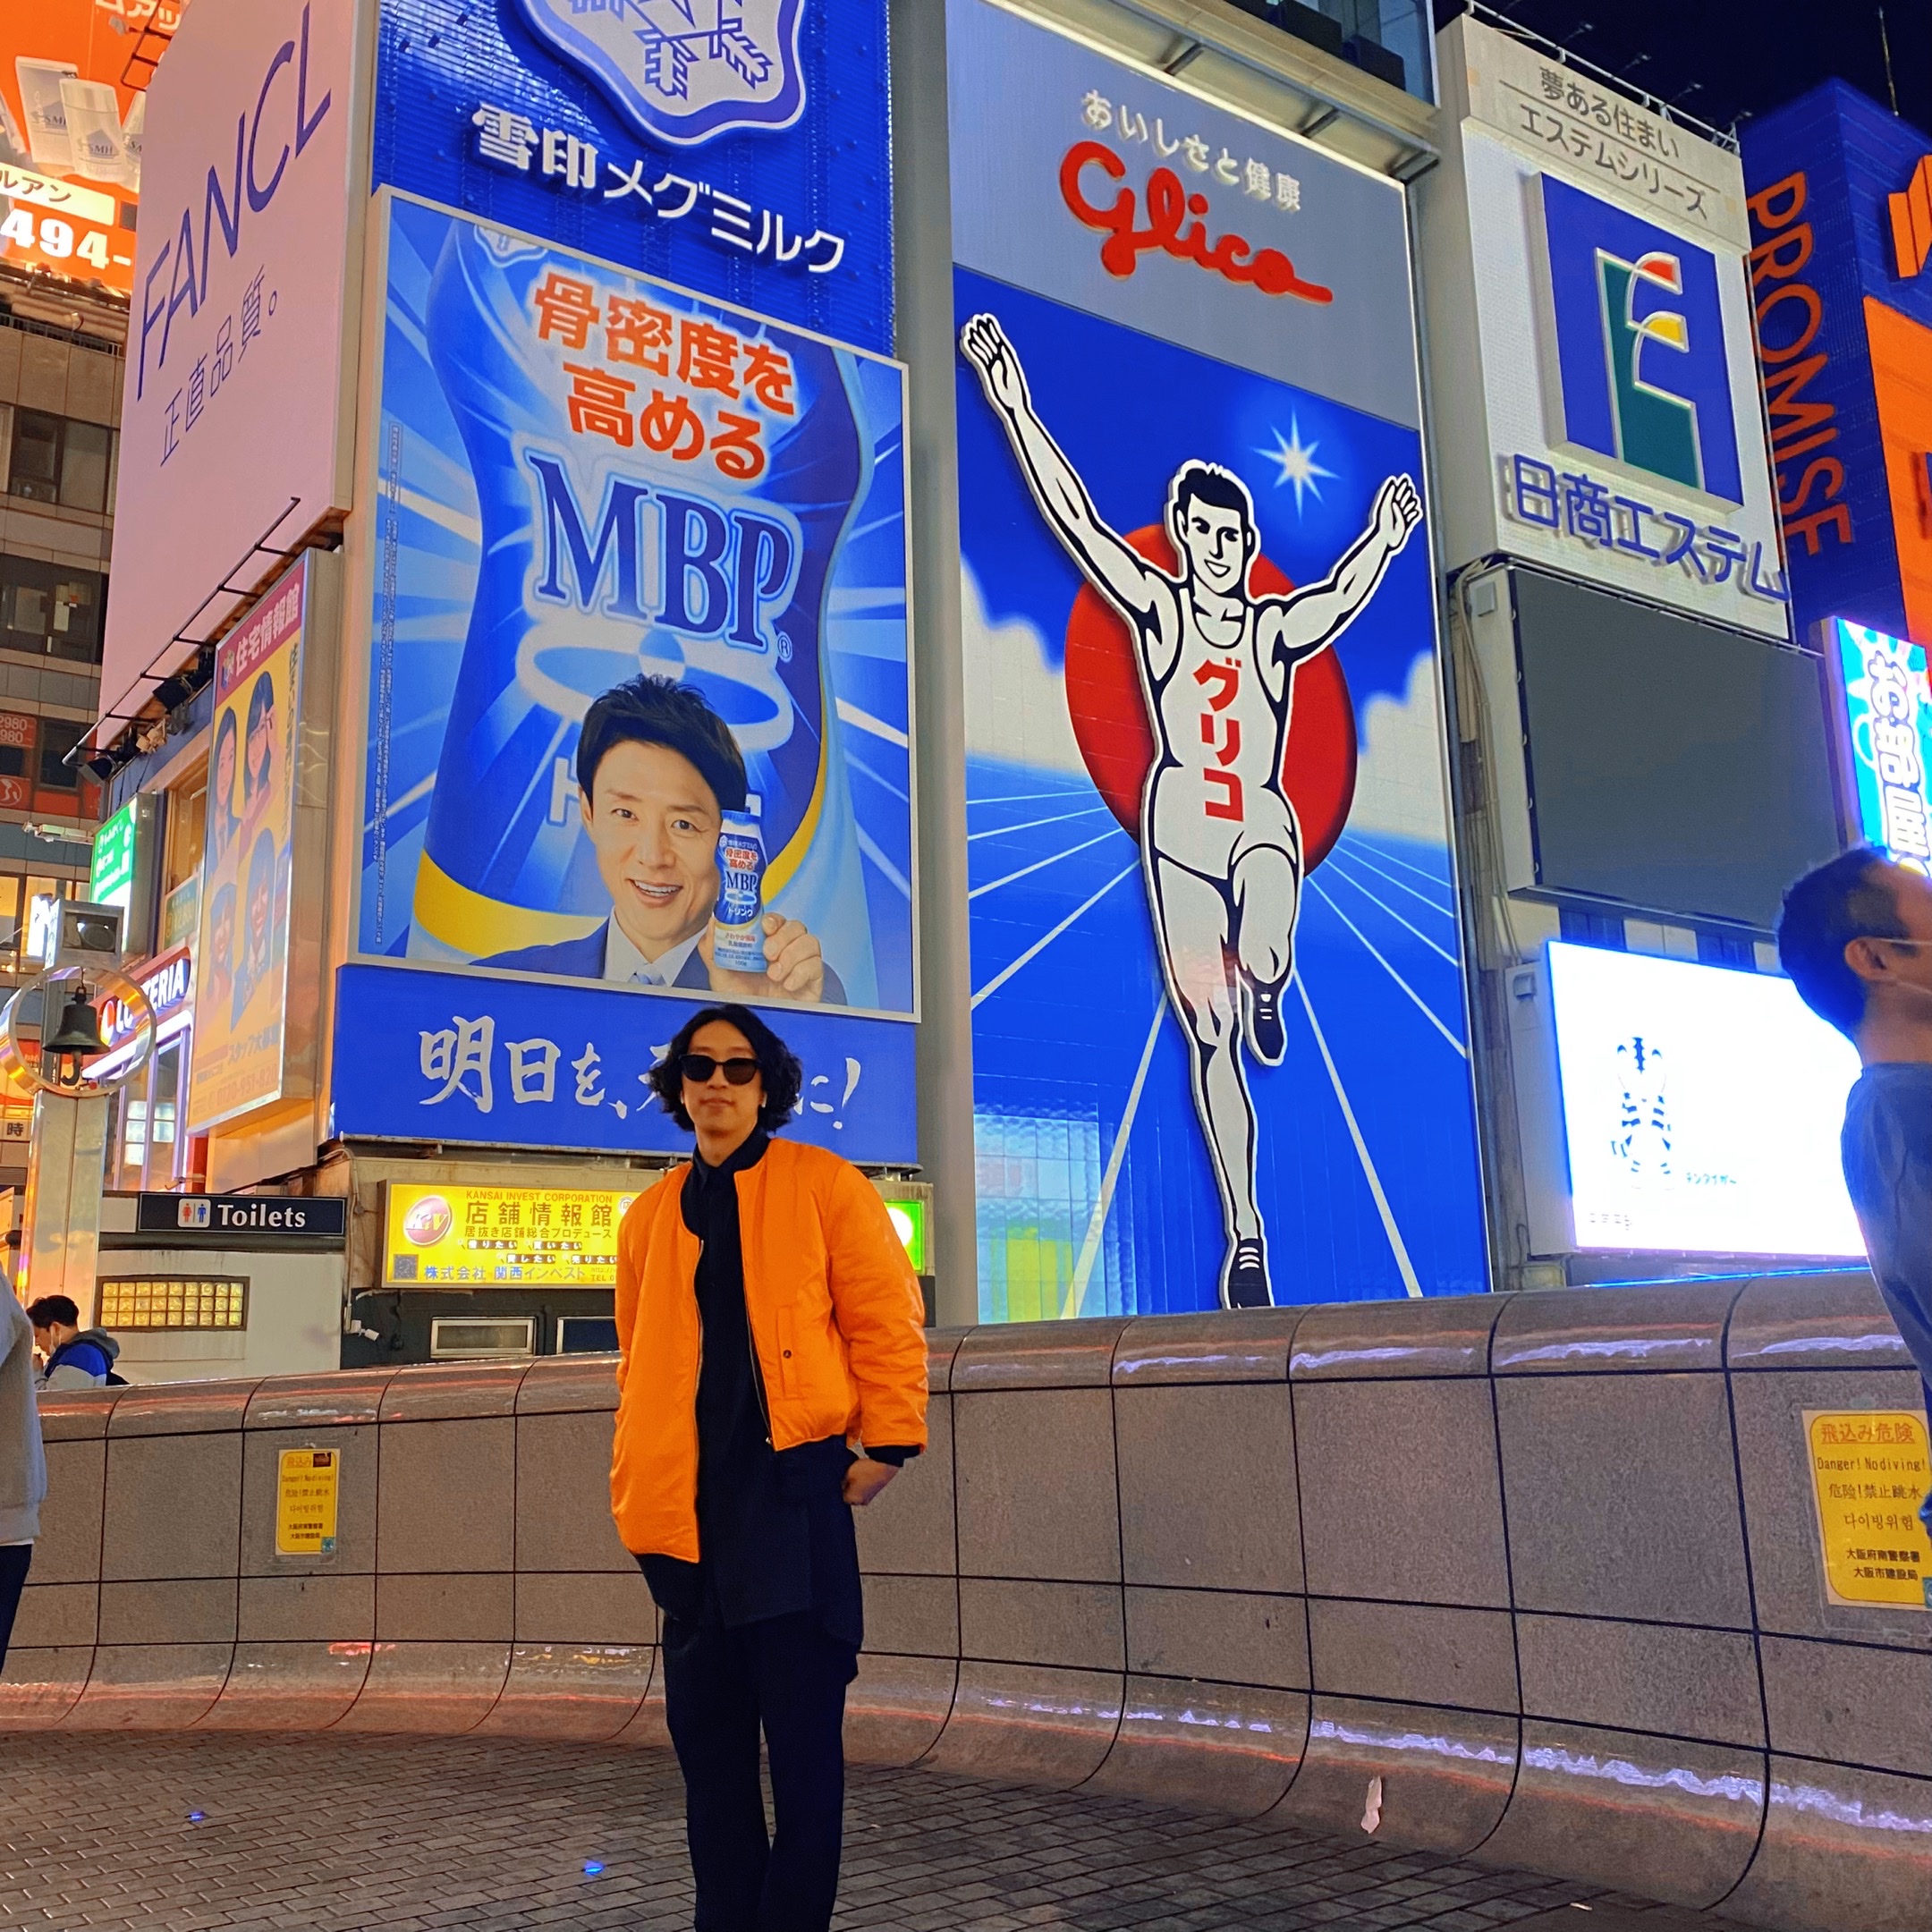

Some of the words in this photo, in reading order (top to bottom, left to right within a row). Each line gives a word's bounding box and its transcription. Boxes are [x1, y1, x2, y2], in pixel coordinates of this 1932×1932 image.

[1080, 89, 1302, 213] おいしさと健康
[1520, 103, 1708, 221] エステムシリーズ
[1538, 65, 1681, 159] 夢ある住まい
[138, 1, 332, 402] FANCL
[471, 101, 844, 274] 雪印メグミルク
[1059, 140, 1334, 305] Glico
[534, 272, 795, 417] 骨密度を
[1745, 171, 1855, 557] PROMISE
[563, 361, 766, 480] 高める
[1509, 453, 1791, 603] 日商エステム
[235, 582, 301, 677] 住宅情報館
[1192, 656, 1244, 823] グリコ
[217, 1203, 306, 1228] Toilets
[464, 1225, 612, 1239] 居抜き店舗総合プロデュース
[465, 1190, 503, 1201] KANSAI
[505, 1191, 542, 1202] INVEST
[544, 1192, 613, 1204] CORPORATION
[465, 1200, 613, 1227] 店舗情報館
[424, 1265, 487, 1282] 株式会社
[494, 1266, 586, 1282] 関西インベスト
[1817, 1456, 1860, 1471] Danger!
[1820, 1422, 1916, 1443] 飛込み危険
[1843, 1513, 1914, 1531] 다이빙위험
